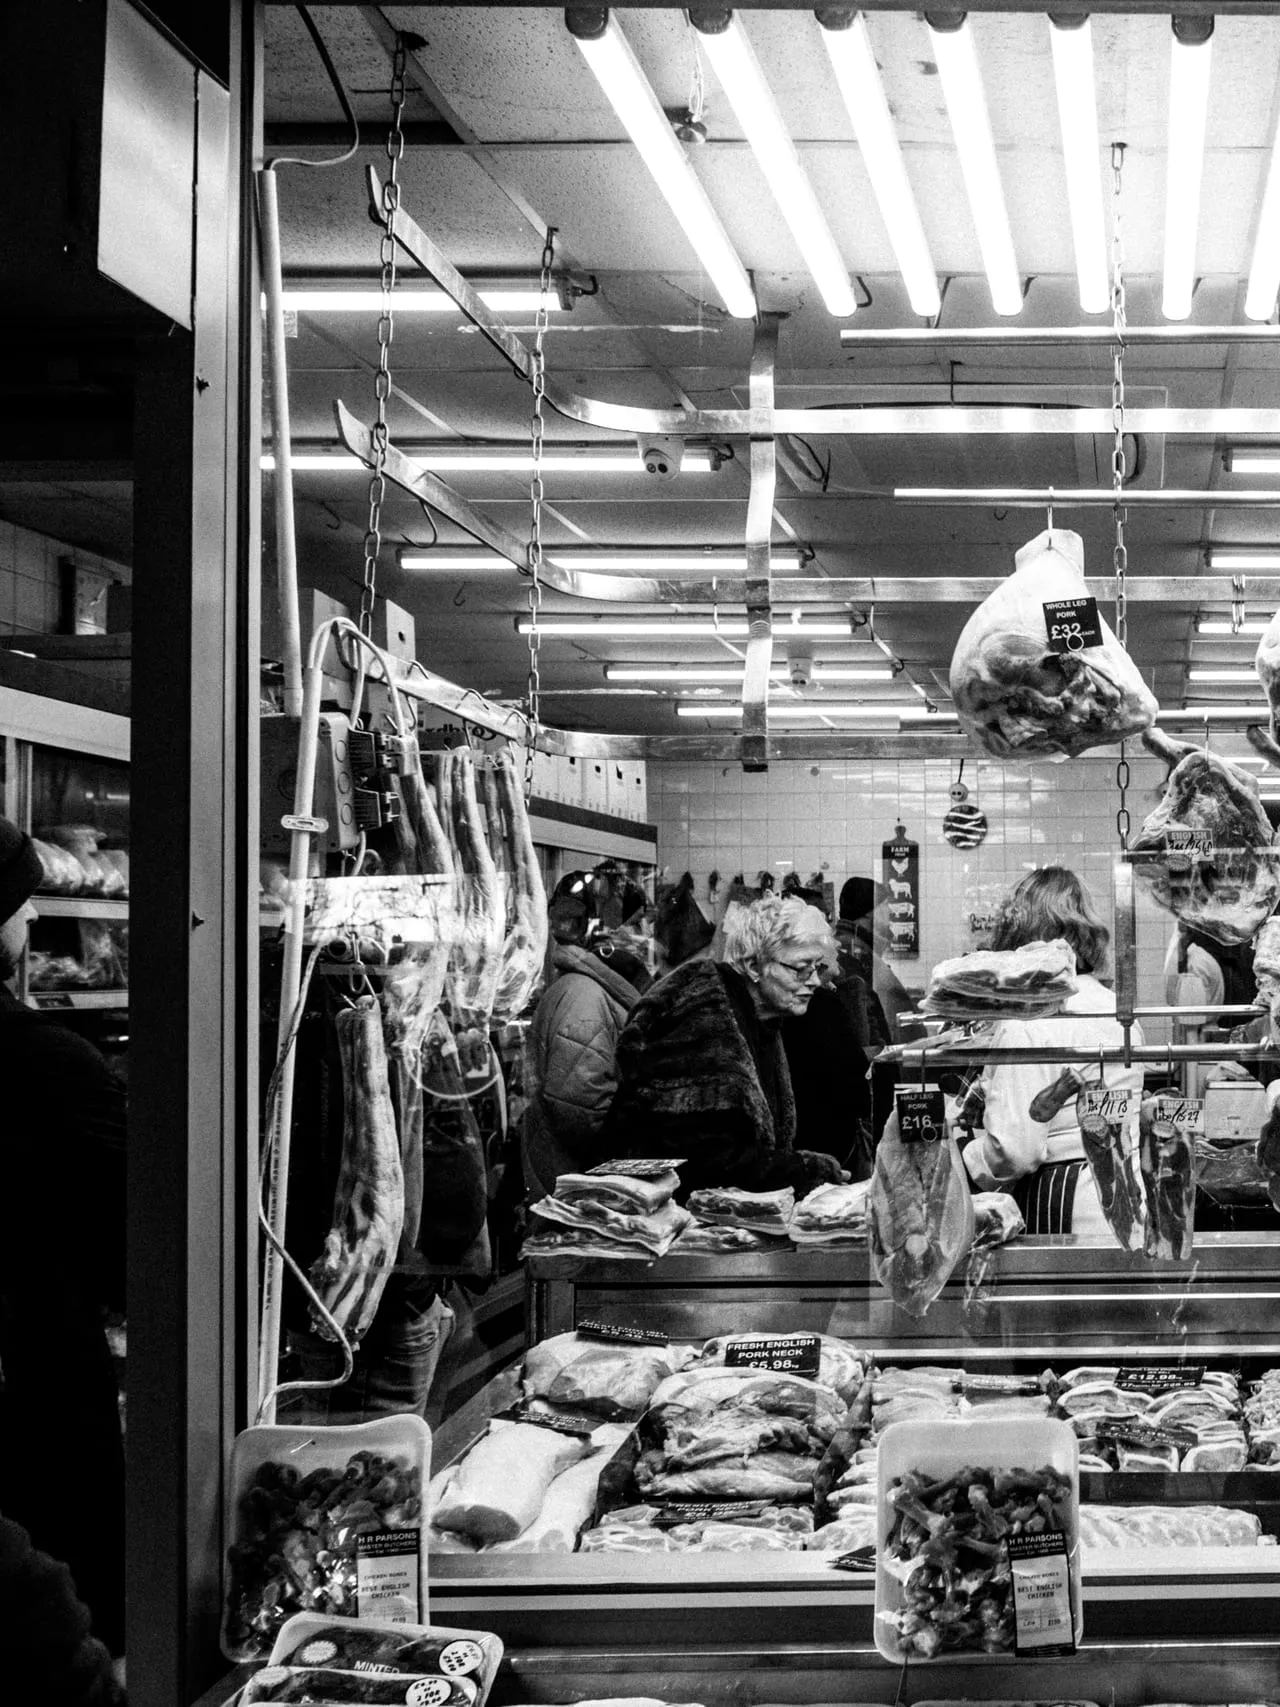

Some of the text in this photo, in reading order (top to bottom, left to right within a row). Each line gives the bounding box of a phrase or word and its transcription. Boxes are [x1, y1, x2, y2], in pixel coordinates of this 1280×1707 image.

[1045, 601, 1071, 610] WHOLE
[1056, 611, 1077, 619] PORK
[1051, 623, 1082, 640] £32
[902, 1115, 932, 1129] £16
[727, 1339, 815, 1351] FRESH ENGLISH
[738, 1349, 803, 1359] PORK NECK
[358, 1532, 417, 1544] H R PARSONS
[1025, 1533, 1063, 1543] PARSONS
[384, 1540, 417, 1548] BUTCHERS
[381, 1582, 410, 1591] ENGLISH
[1036, 1582, 1062, 1591] ENGLISH
[1028, 1591, 1054, 1600] CHICKEN
